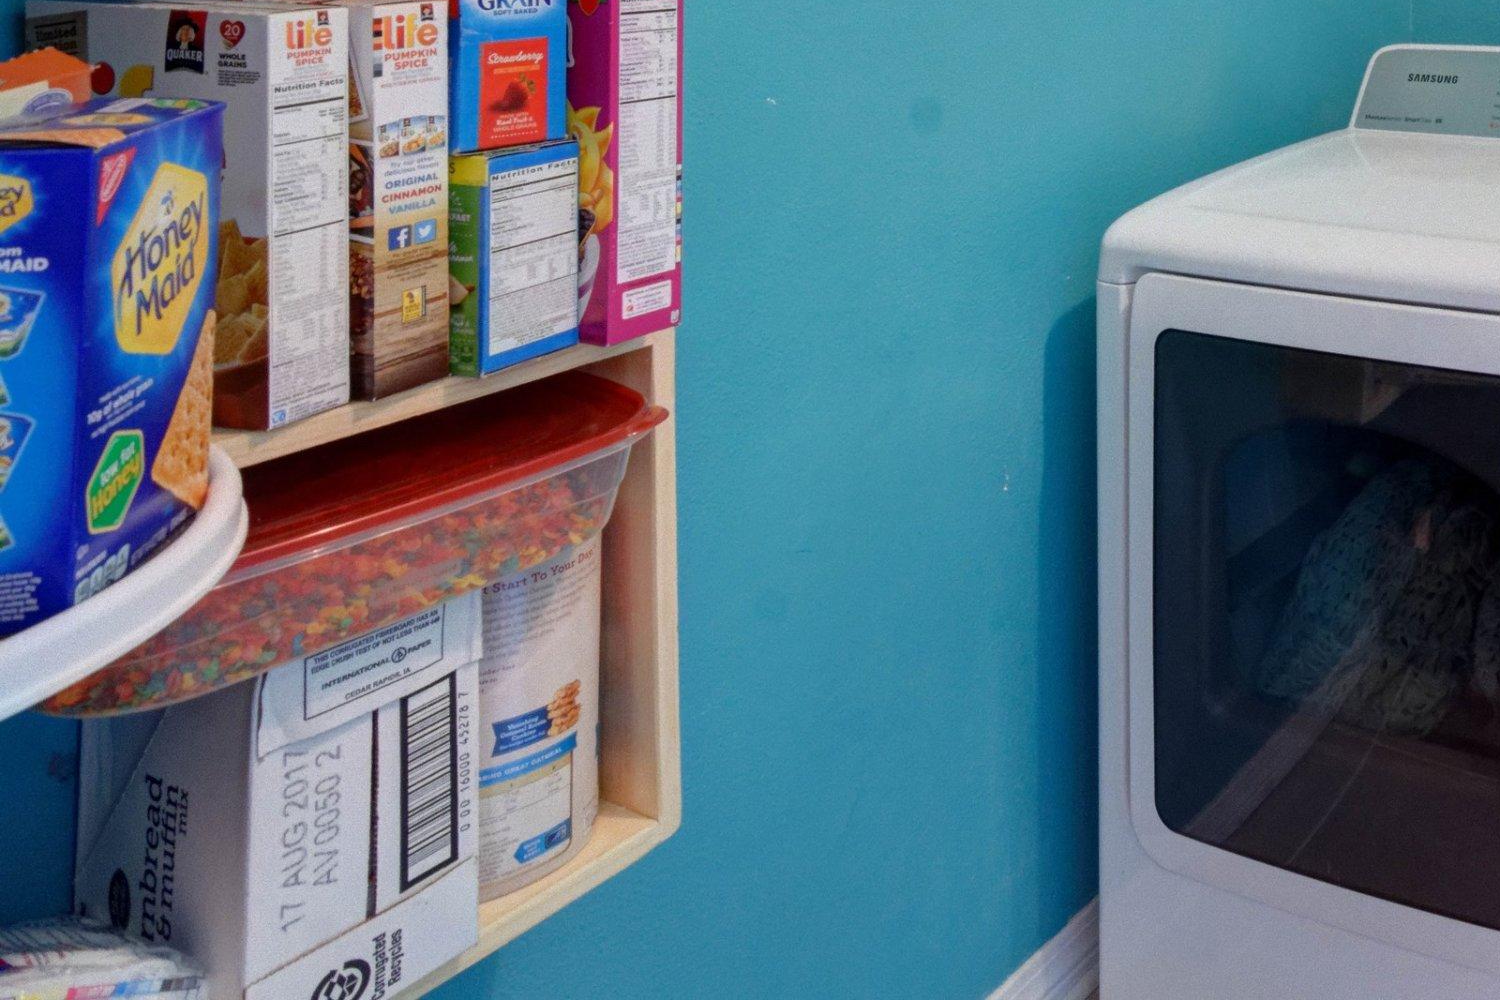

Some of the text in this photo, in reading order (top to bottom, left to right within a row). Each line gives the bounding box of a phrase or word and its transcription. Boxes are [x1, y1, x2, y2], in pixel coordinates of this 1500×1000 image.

[224, 24, 240, 37] 20
[286, 19, 333, 50] life
[384, 13, 438, 50] life
[167, 49, 203, 62] QUAKER
[218, 53, 246, 61] WHOLE
[287, 47, 332, 59] PUMPKIN
[295, 56, 324, 67] SPICE
[384, 48, 438, 62] PUMPKIN
[487, 50, 544, 65] Strawberry
[217, 61, 248, 69] GRAINS
[395, 58, 429, 70] SPICE
[273, 77, 344, 94] Nutrition Facts
[1407, 72, 1459, 85] SAMSUNG
[491, 159, 577, 181] Nutrition Facts
[385, 173, 438, 190] ORIGINAL
[381, 184, 442, 204] CINNAMON
[389, 198, 436, 214] VANILLA
[119, 190, 204, 310] Honey
[134, 248, 196, 336] Maid
[492, 577, 527, 594] Start
[531, 571, 547, 583] To
[550, 560, 576, 576] Your
[311, 663, 330, 676] EDGE
[331, 653, 355, 667] CRUSH
[355, 645, 372, 657] TEST
[382, 636, 396, 646] NOT
[397, 628, 412, 639] LESS
[413, 621, 430, 634] THAN
[314, 653, 329, 665] THIS
[330, 639, 371, 658] CORRUGATED
[322, 638, 432, 691] INTERNATIONAL PAPER
[344, 683, 372, 700] CEDAR
[177, 788, 190, 837] mix
[159, 785, 180, 908] muffin
[280, 749, 310, 933] 17 AUG 2017
[371, 932, 388, 1000] Corrugated
[387, 928, 404, 987] Recycles
